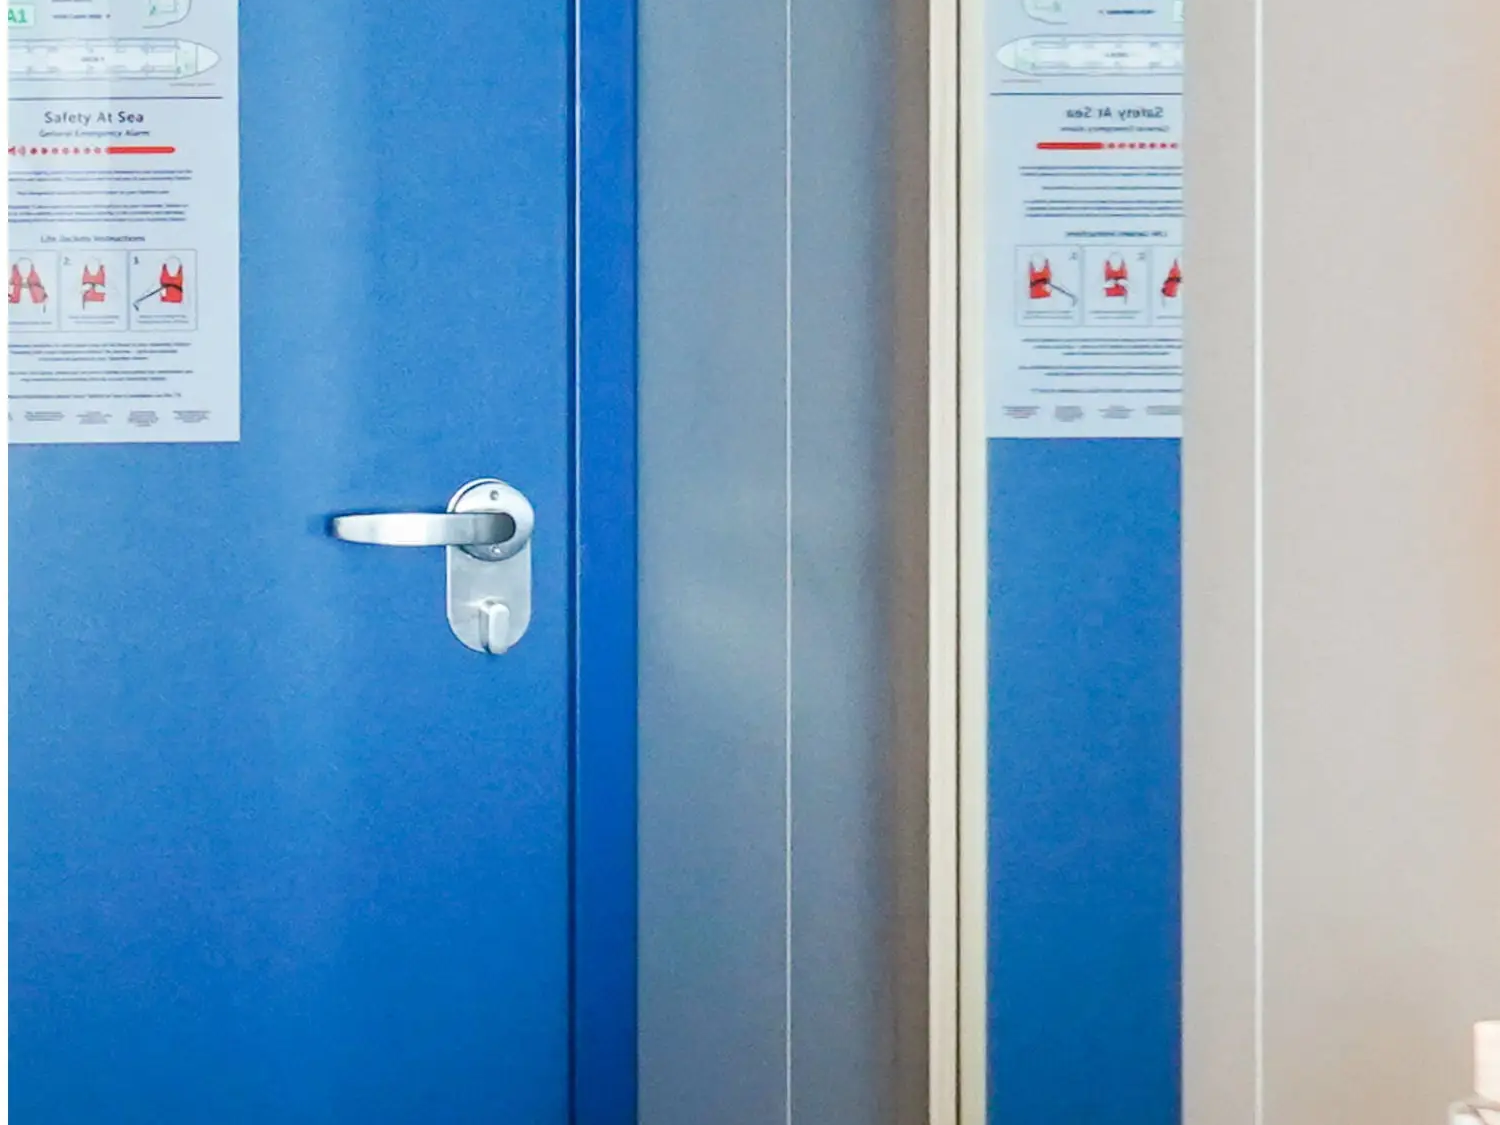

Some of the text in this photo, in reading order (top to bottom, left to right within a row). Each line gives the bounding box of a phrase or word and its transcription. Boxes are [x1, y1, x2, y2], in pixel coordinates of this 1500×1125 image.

[43, 110, 145, 127] Safety At Sea
